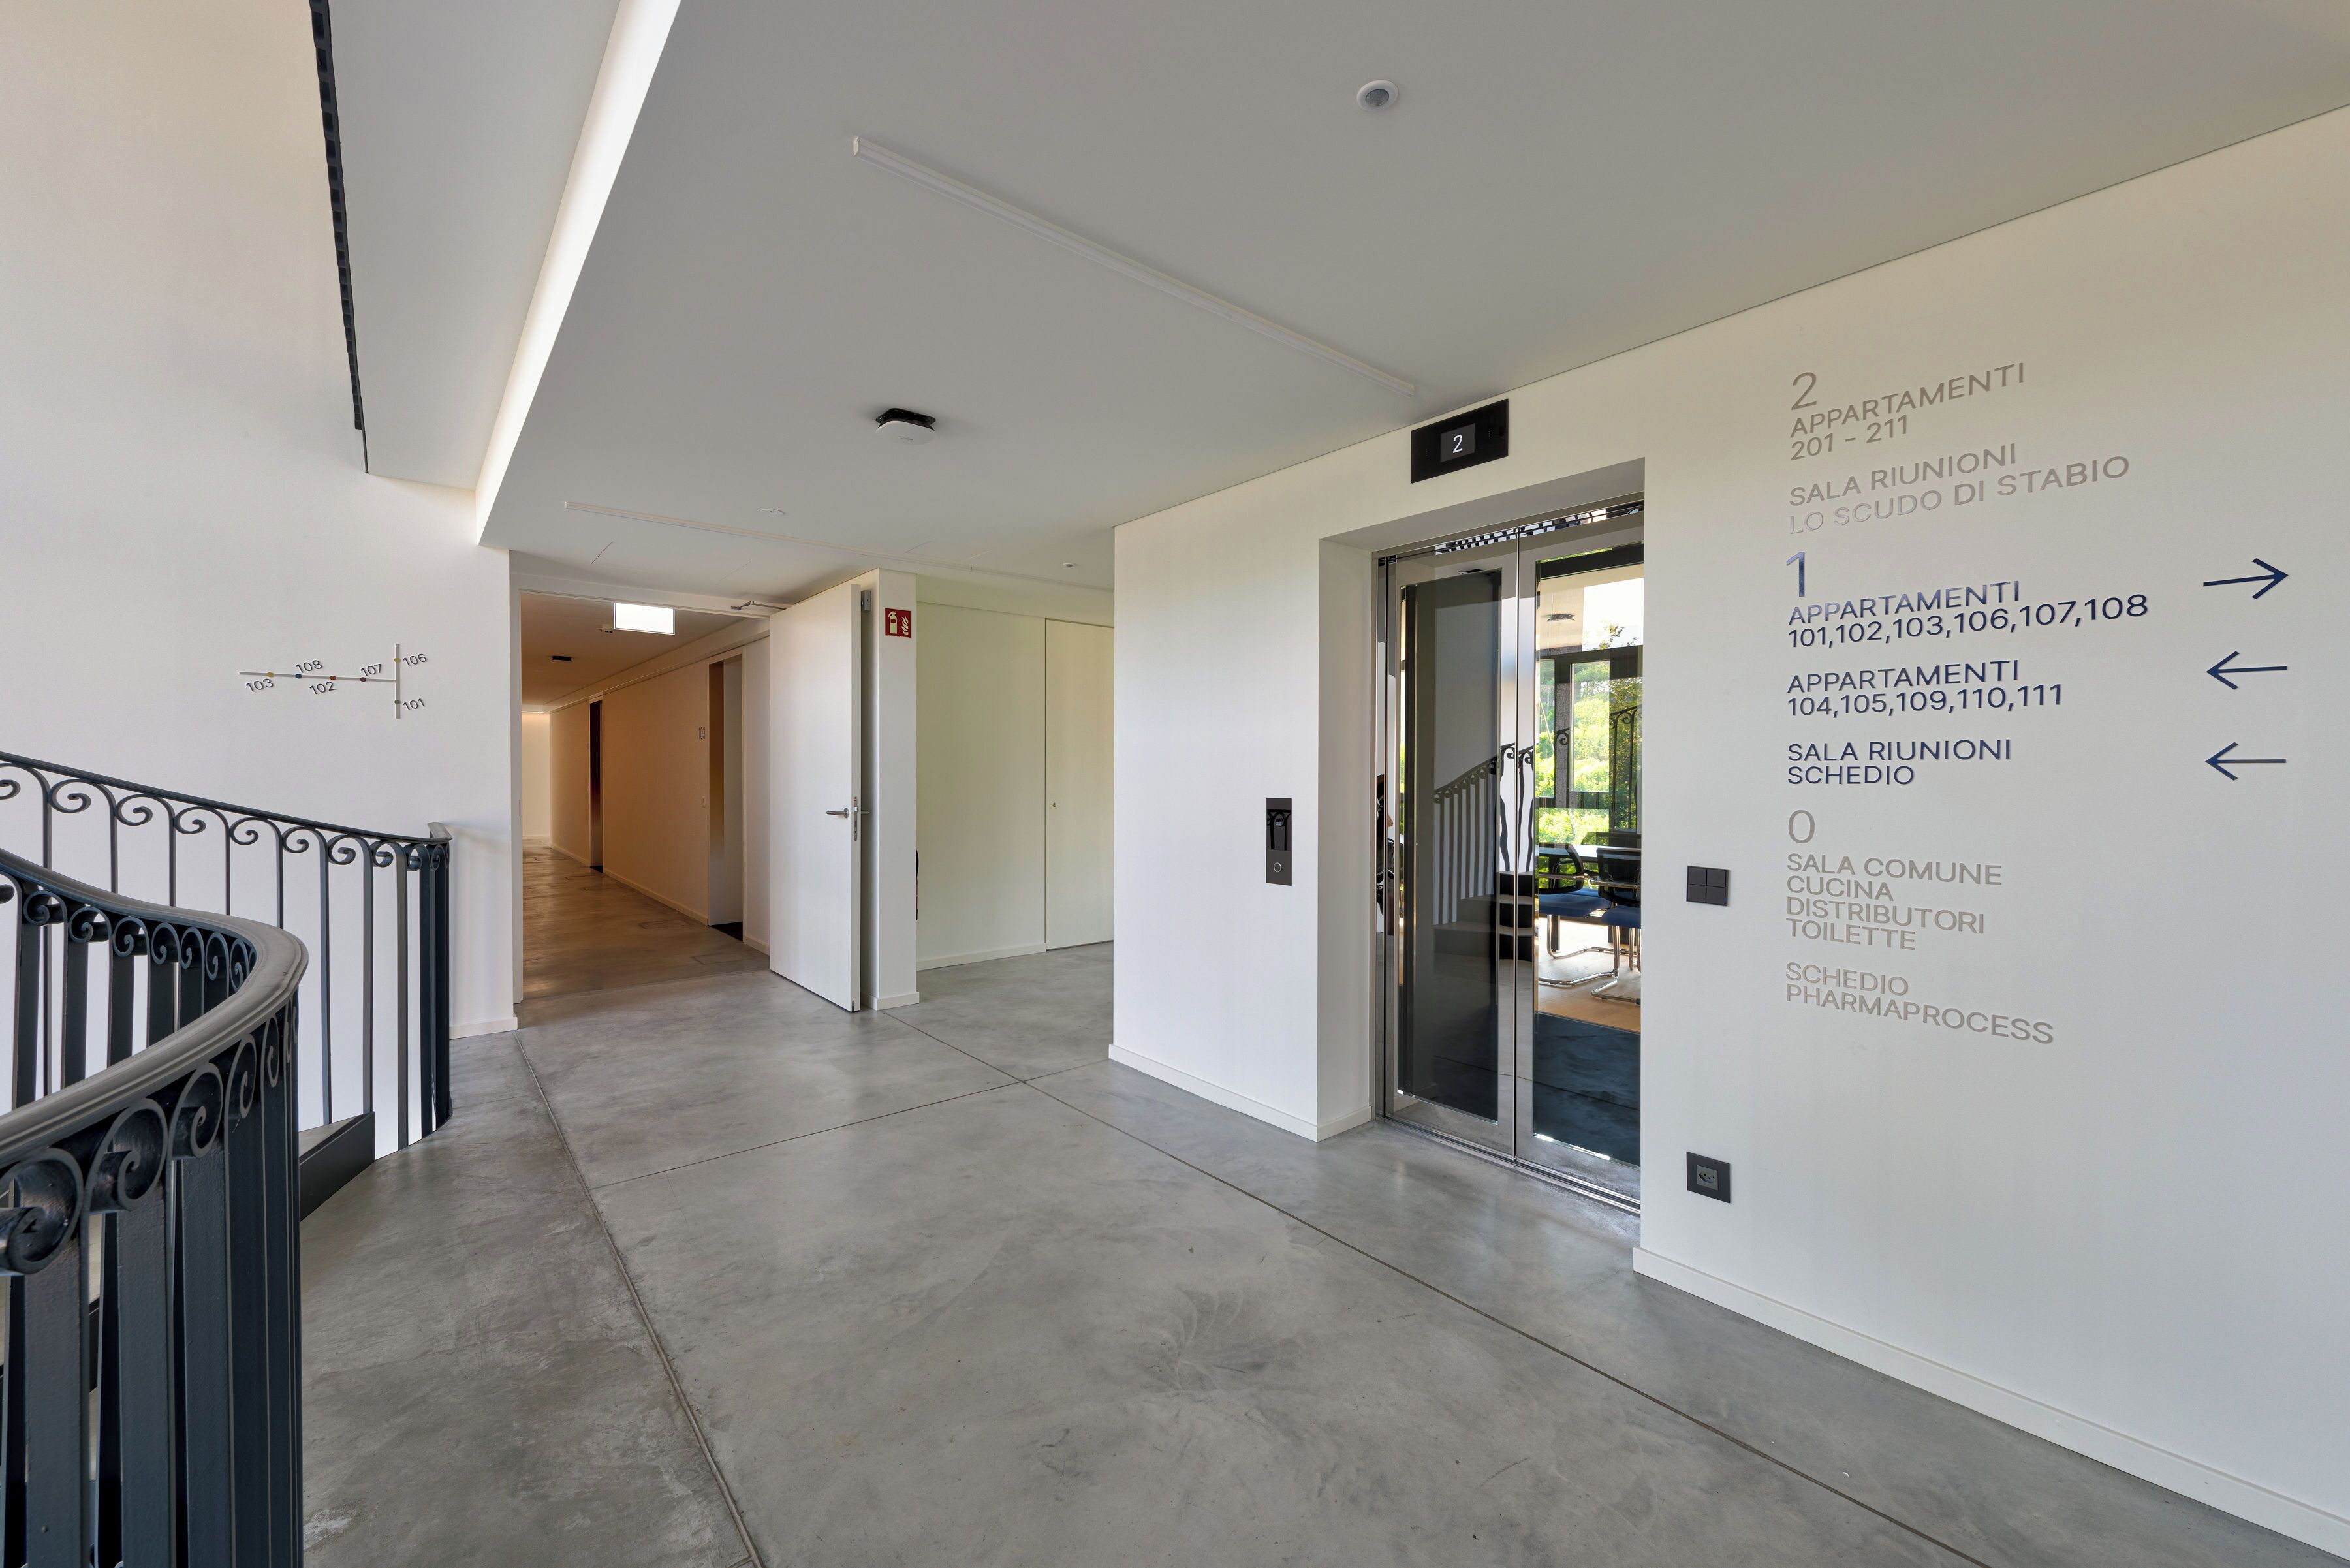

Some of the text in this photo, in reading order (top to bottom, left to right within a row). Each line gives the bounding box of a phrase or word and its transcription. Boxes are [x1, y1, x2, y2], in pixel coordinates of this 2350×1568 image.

[1791, 373, 1817, 410] 2
[1791, 362, 2025, 437] APPARTAMENTI
[1453, 435, 1462, 453] 2
[1792, 433, 1834, 461] 201
[1866, 416, 1908, 443] 211
[1790, 444, 2016, 507] SALA RIUNIONI
[1790, 456, 2129, 535] LO SCUDO DI STABIO
[1786, 552, 1805, 597] 1
[1789, 582, 2019, 626] APPARTAMENTI
[296, 660, 322, 674] 108
[360, 663, 383, 676] 107
[403, 653, 426, 666] 106
[246, 678, 274, 692] 103
[309, 682, 336, 695] 102
[1788, 661, 2018, 693] APPARTAMENTI
[403, 698, 425, 711] 101
[1788, 740, 2011, 761] SALA RIUNIONI
[1787, 766, 1914, 785] SCHEDIO
[1788, 810, 1815, 843] 0
[1787, 853, 2002, 885] SALA COMUNE
[1787, 876, 1893, 901] CUCINA
[1787, 897, 1984, 934] DISTRIBUTORI
[1786, 918, 1916, 950] TOILETTE
[1786, 962, 1909, 996] SCHEDIO
[1786, 984, 2054, 1044] PHARMAPROCESS
